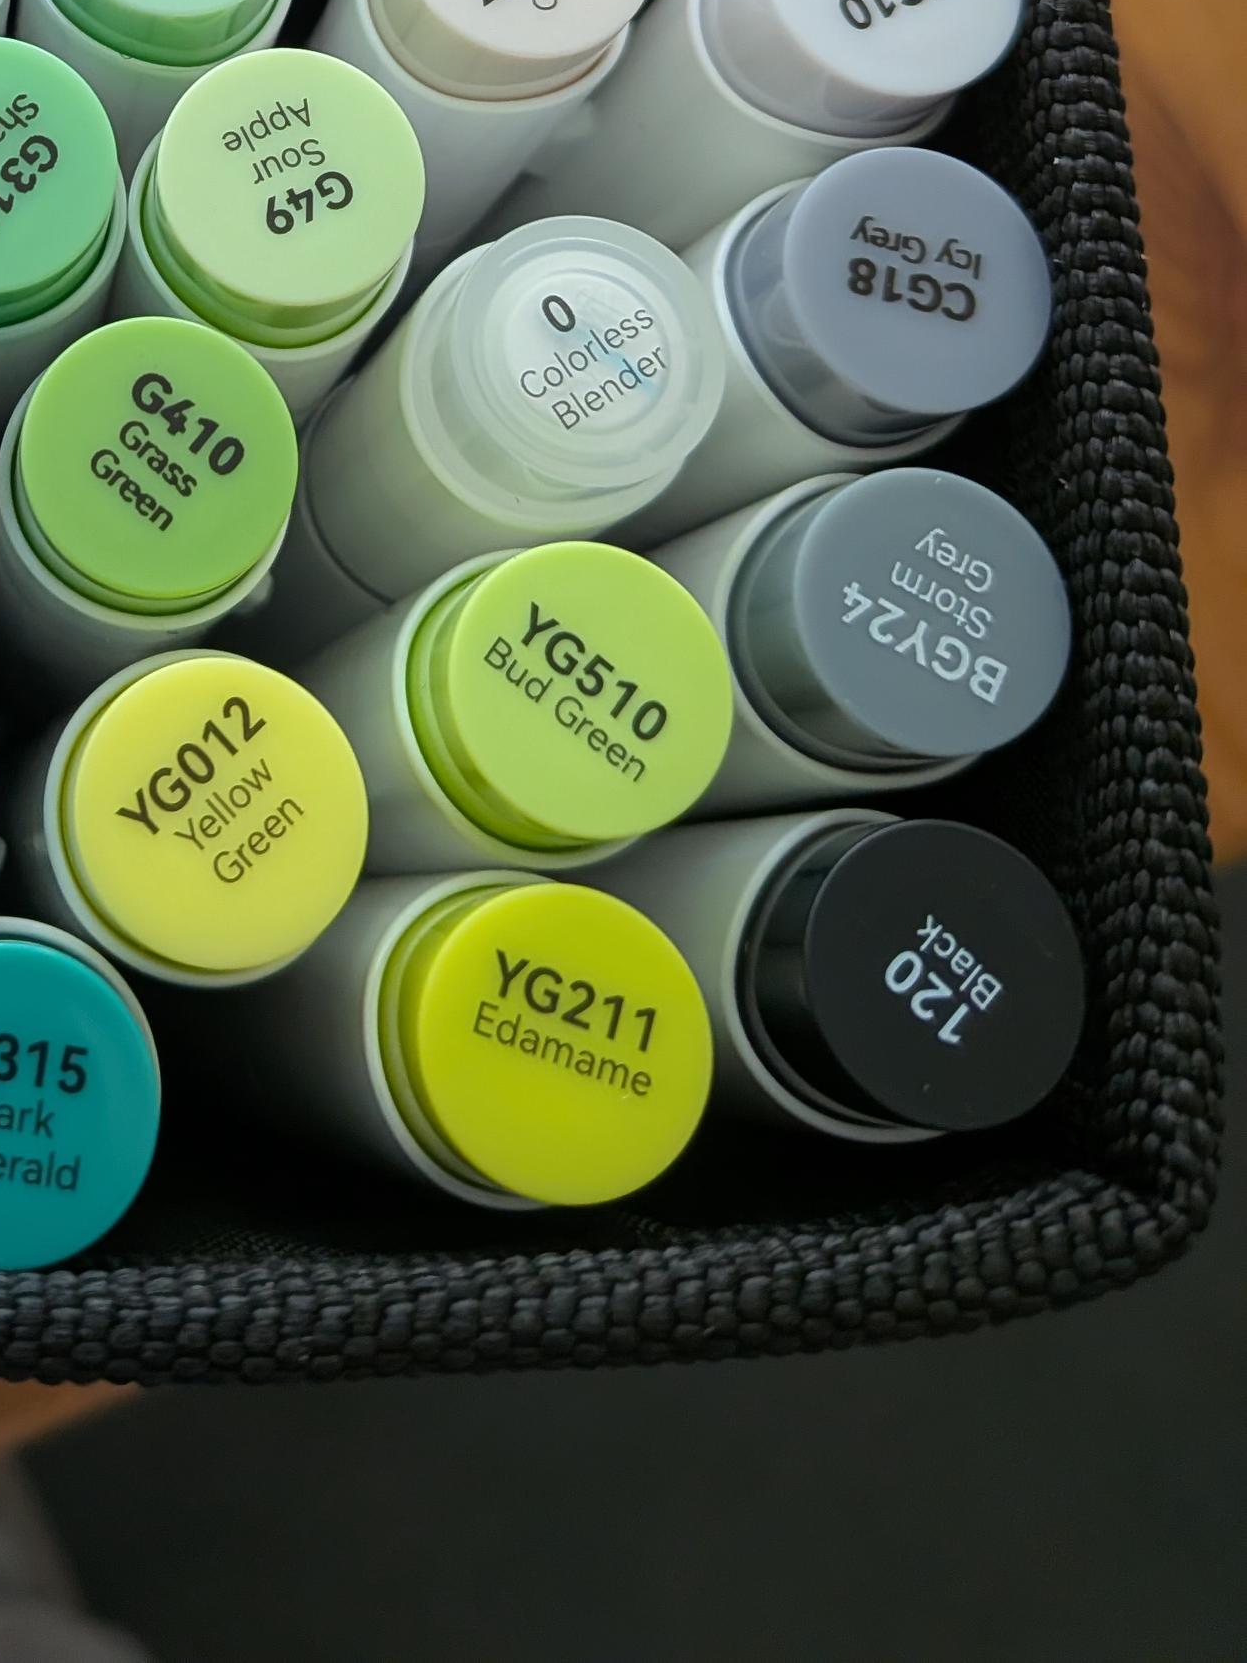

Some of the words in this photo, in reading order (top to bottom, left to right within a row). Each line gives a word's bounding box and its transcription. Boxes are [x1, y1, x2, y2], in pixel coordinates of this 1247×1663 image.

[221, 98, 313, 153] Apple
[253, 138, 326, 185] Sour
[265, 170, 355, 235] G49
[849, 215, 927, 266] Grey
[846, 257, 978, 324] CG18
[934, 237, 983, 281] Icy
[519, 305, 656, 401] Colorless
[540, 294, 576, 334] 0
[131, 372, 246, 478] G410
[550, 344, 670, 432] Blender
[89, 448, 175, 533] Green
[118, 420, 199, 499] Grass
[890, 560, 994, 640] Storm
[915, 526, 995, 594] Grey
[518, 601, 669, 742] YG510
[840, 579, 1009, 706] BGY24
[483, 635, 555, 704] Bud
[552, 694, 648, 783] Green
[116, 695, 267, 838] YG012
[173, 756, 275, 854] Yellow
[212, 792, 305, 886] Green
[493, 948, 658, 1053] YG211
[883, 949, 965, 1048] 120
[915, 913, 1004, 1012] Black
[472, 1000, 654, 1099] Edamame
